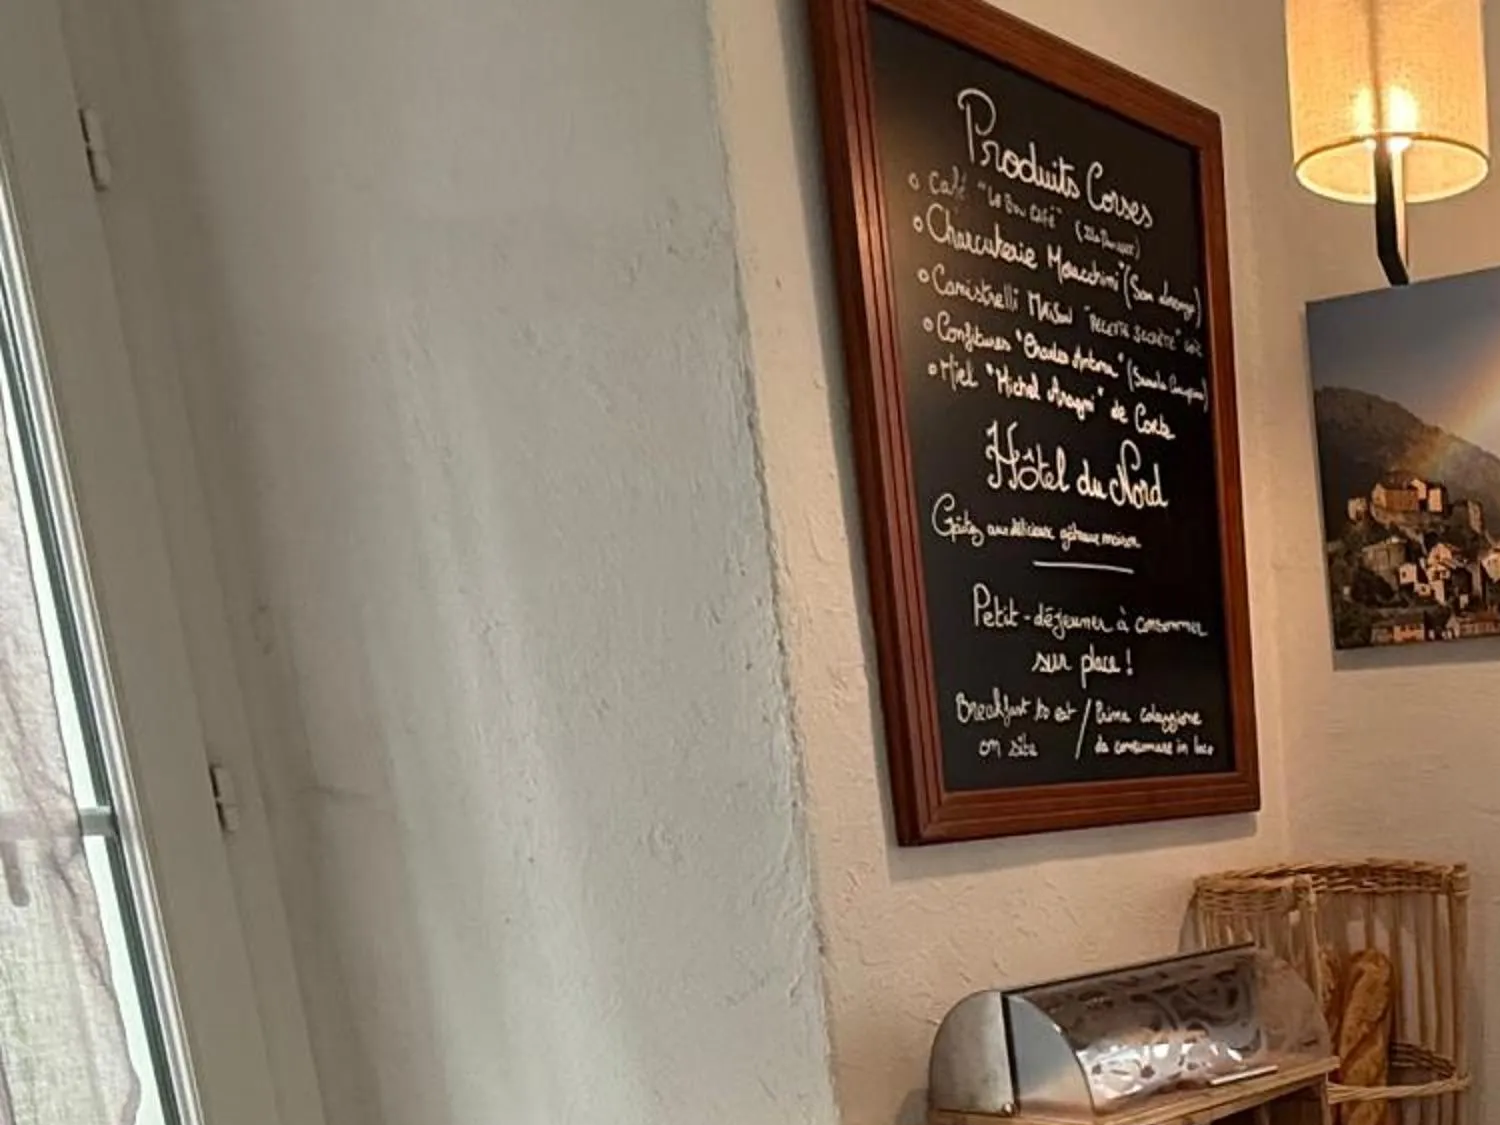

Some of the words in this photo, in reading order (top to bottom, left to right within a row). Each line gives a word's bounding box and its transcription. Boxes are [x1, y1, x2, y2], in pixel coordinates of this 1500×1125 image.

[957, 88, 1080, 200] Produits
[1086, 161, 1153, 229] Corses
[926, 206, 1038, 269] Charcuterie
[932, 263, 1018, 312] Canistrelli
[937, 310, 1011, 353] Confitures
[940, 354, 979, 393] Miel
[1110, 400, 1129, 424] de
[985, 420, 1070, 493] Hôtel
[1076, 457, 1107, 500] du
[1109, 439, 1169, 510] Nord
[973, 583, 1113, 640] Petit-déjeuner
[1115, 604, 1130, 634] à
[1031, 650, 1072, 673] sur
[955, 687, 1031, 728] Breakfast
[979, 738, 1001, 758] on
